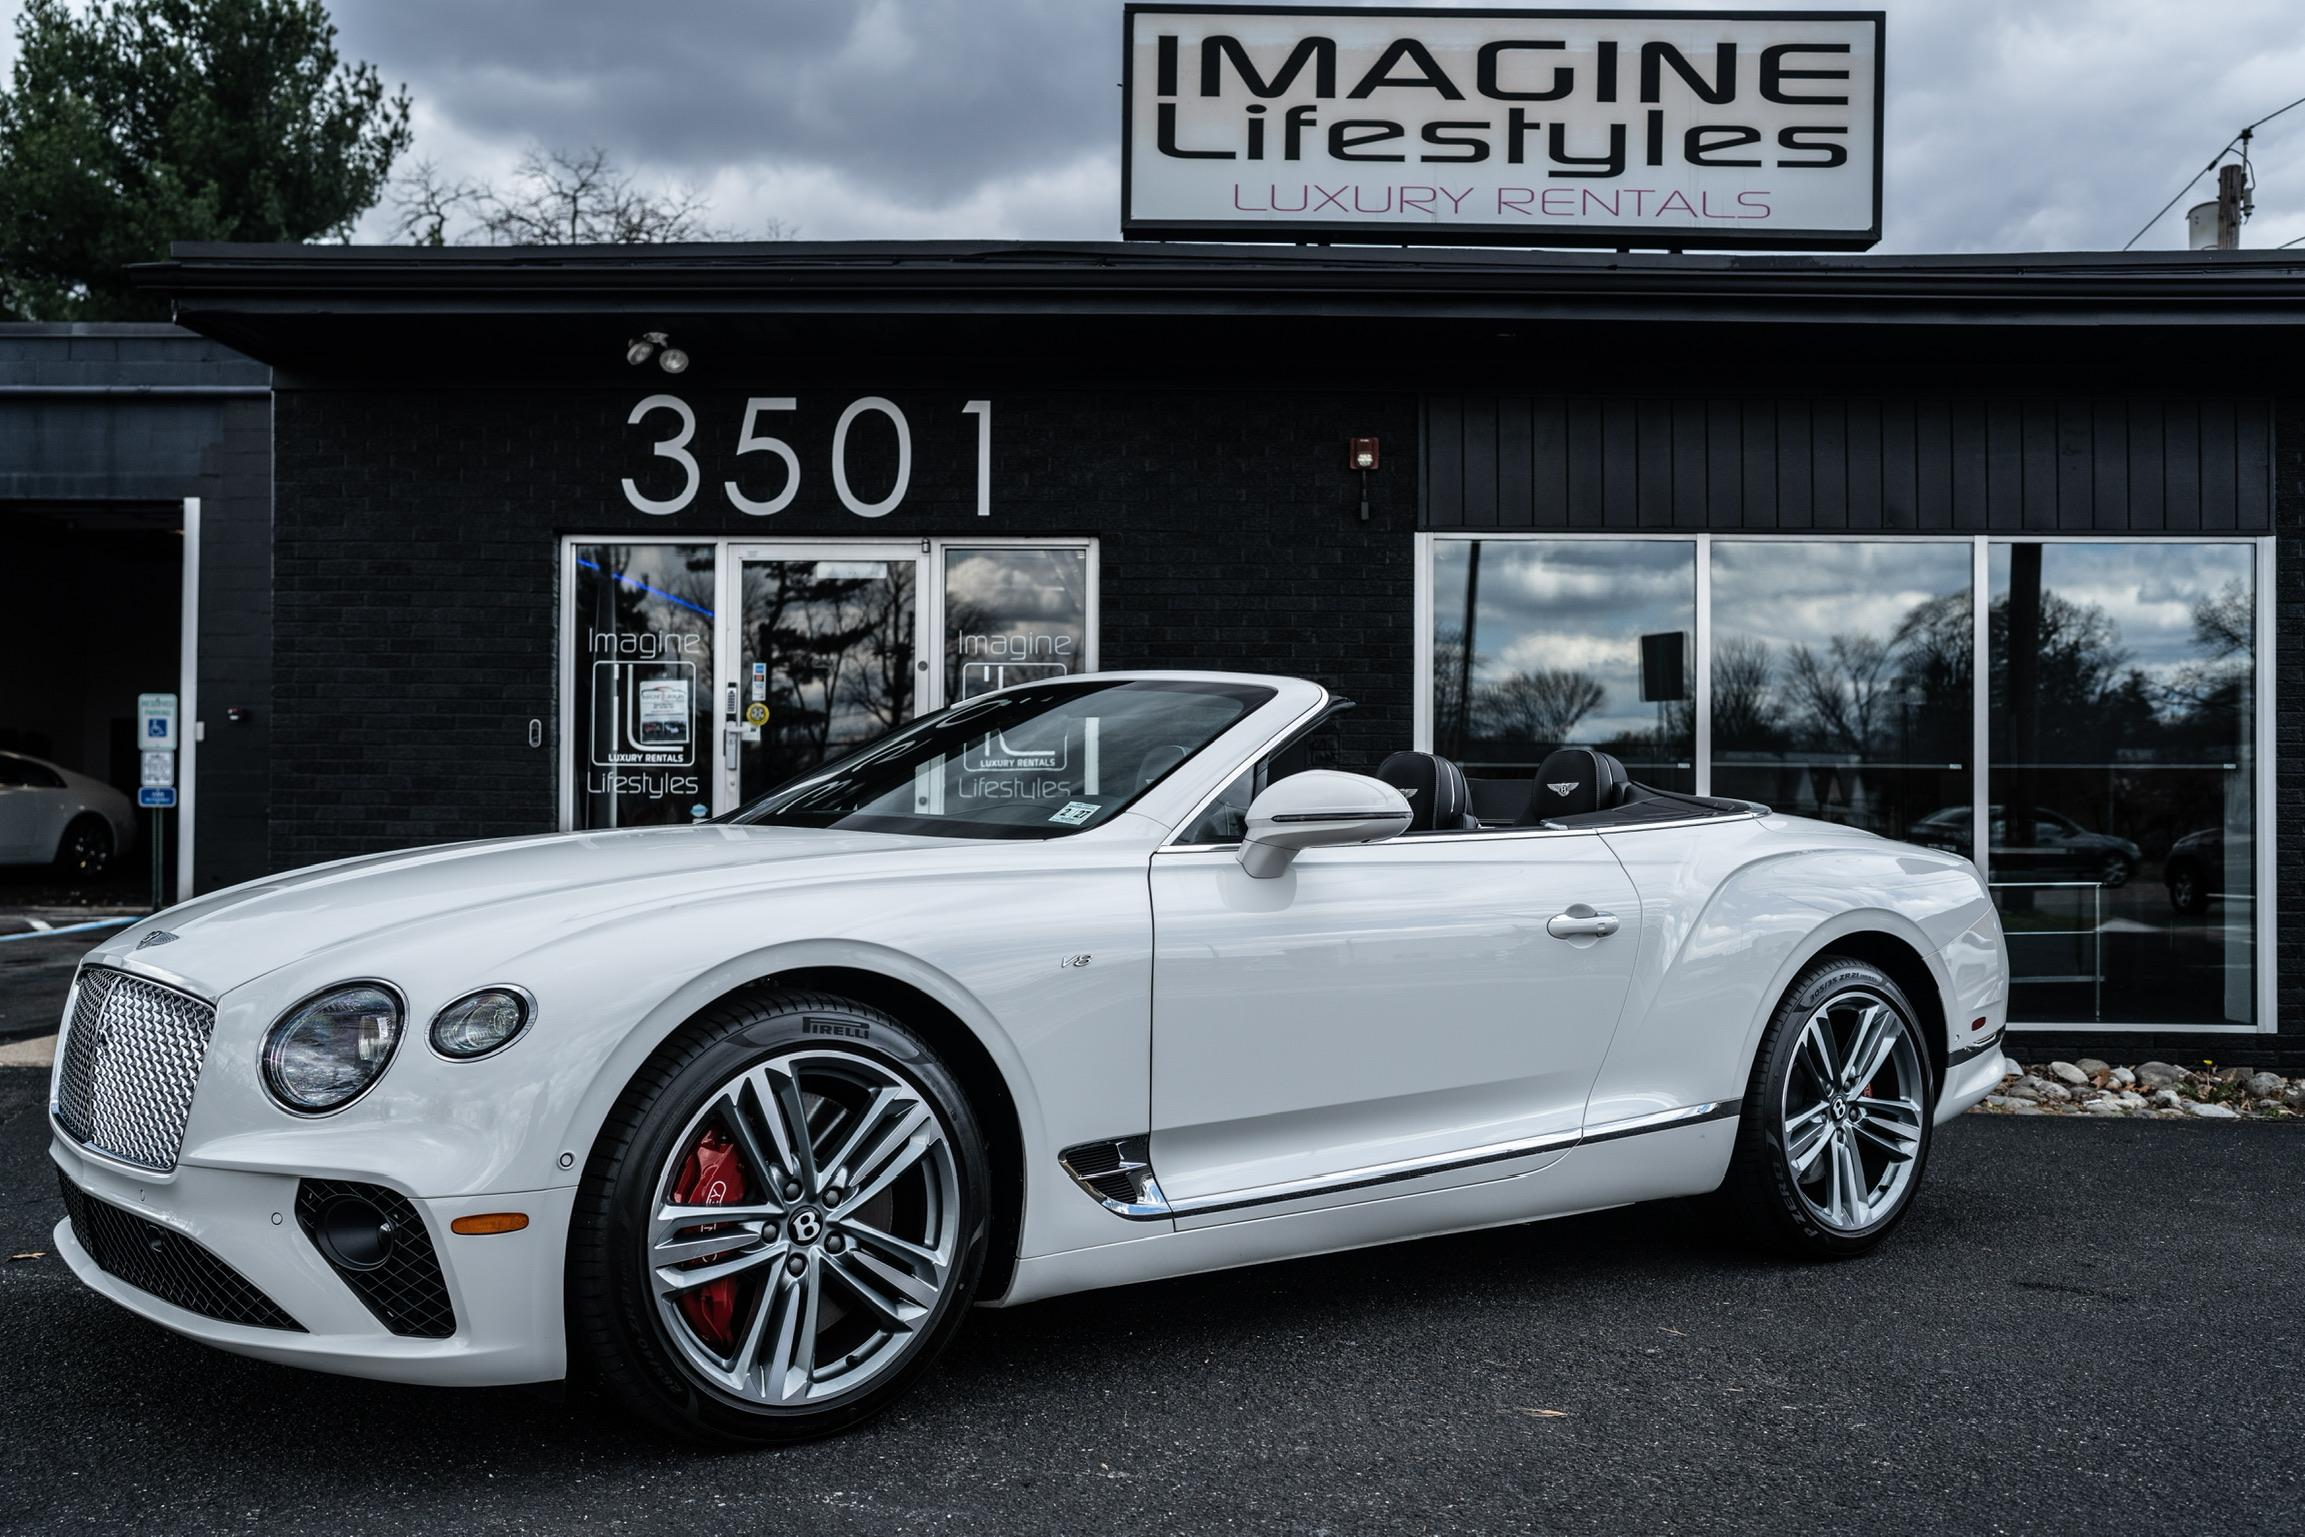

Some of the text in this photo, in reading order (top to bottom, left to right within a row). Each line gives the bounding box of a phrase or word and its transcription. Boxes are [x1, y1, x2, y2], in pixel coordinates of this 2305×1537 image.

[1157, 35, 1851, 105] IMAGINE
[1157, 103, 1848, 178] Lifestyles
[1234, 184, 1772, 219] LUXURY RENTALS
[621, 394, 991, 518] 3501
[588, 627, 700, 659] Imagine
[958, 629, 1072, 661] Imagine
[608, 753, 683, 763] LUXURY RENTALS
[980, 758, 1056, 768] LUXURY RENTALS
[587, 771, 699, 799] Lifestyles
[958, 777, 1071, 800] Lifestyles
[802, 1016, 870, 1039] PIRELLI
[792, 1211, 821, 1241] B
